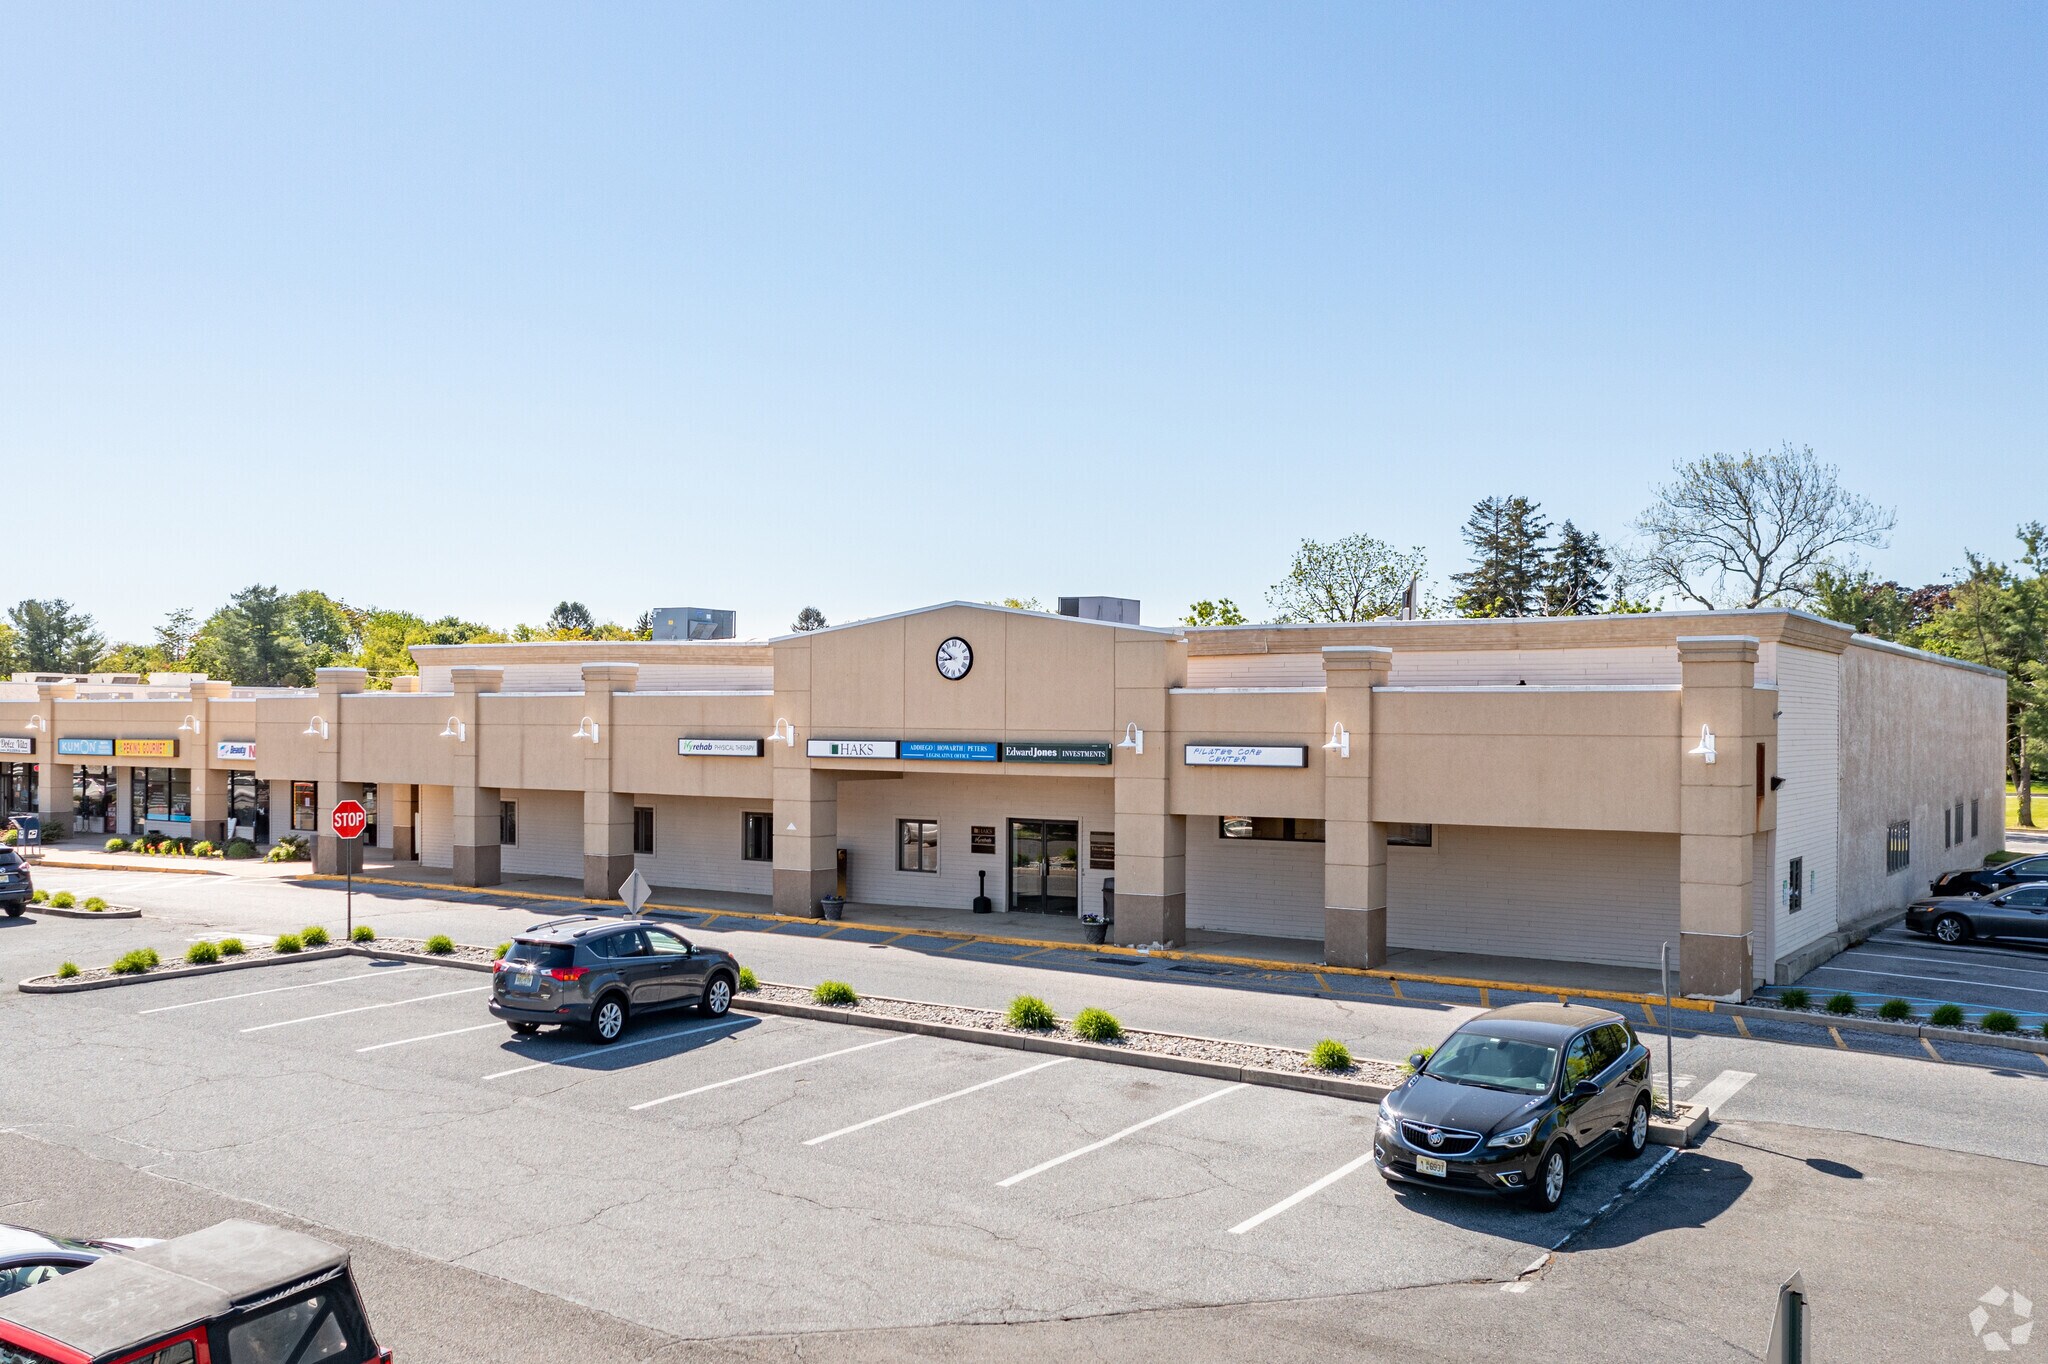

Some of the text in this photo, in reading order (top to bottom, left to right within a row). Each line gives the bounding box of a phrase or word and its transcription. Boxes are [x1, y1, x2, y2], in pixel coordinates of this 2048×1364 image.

[62, 740, 96, 754] KUMON
[123, 743, 140, 754] PEKING
[143, 743, 166, 754] GOURMET
[230, 745, 246, 756] Beauty
[840, 743, 874, 756] HAKS
[1062, 750, 1105, 758] INVESTMENTS
[334, 812, 364, 827] STOP
